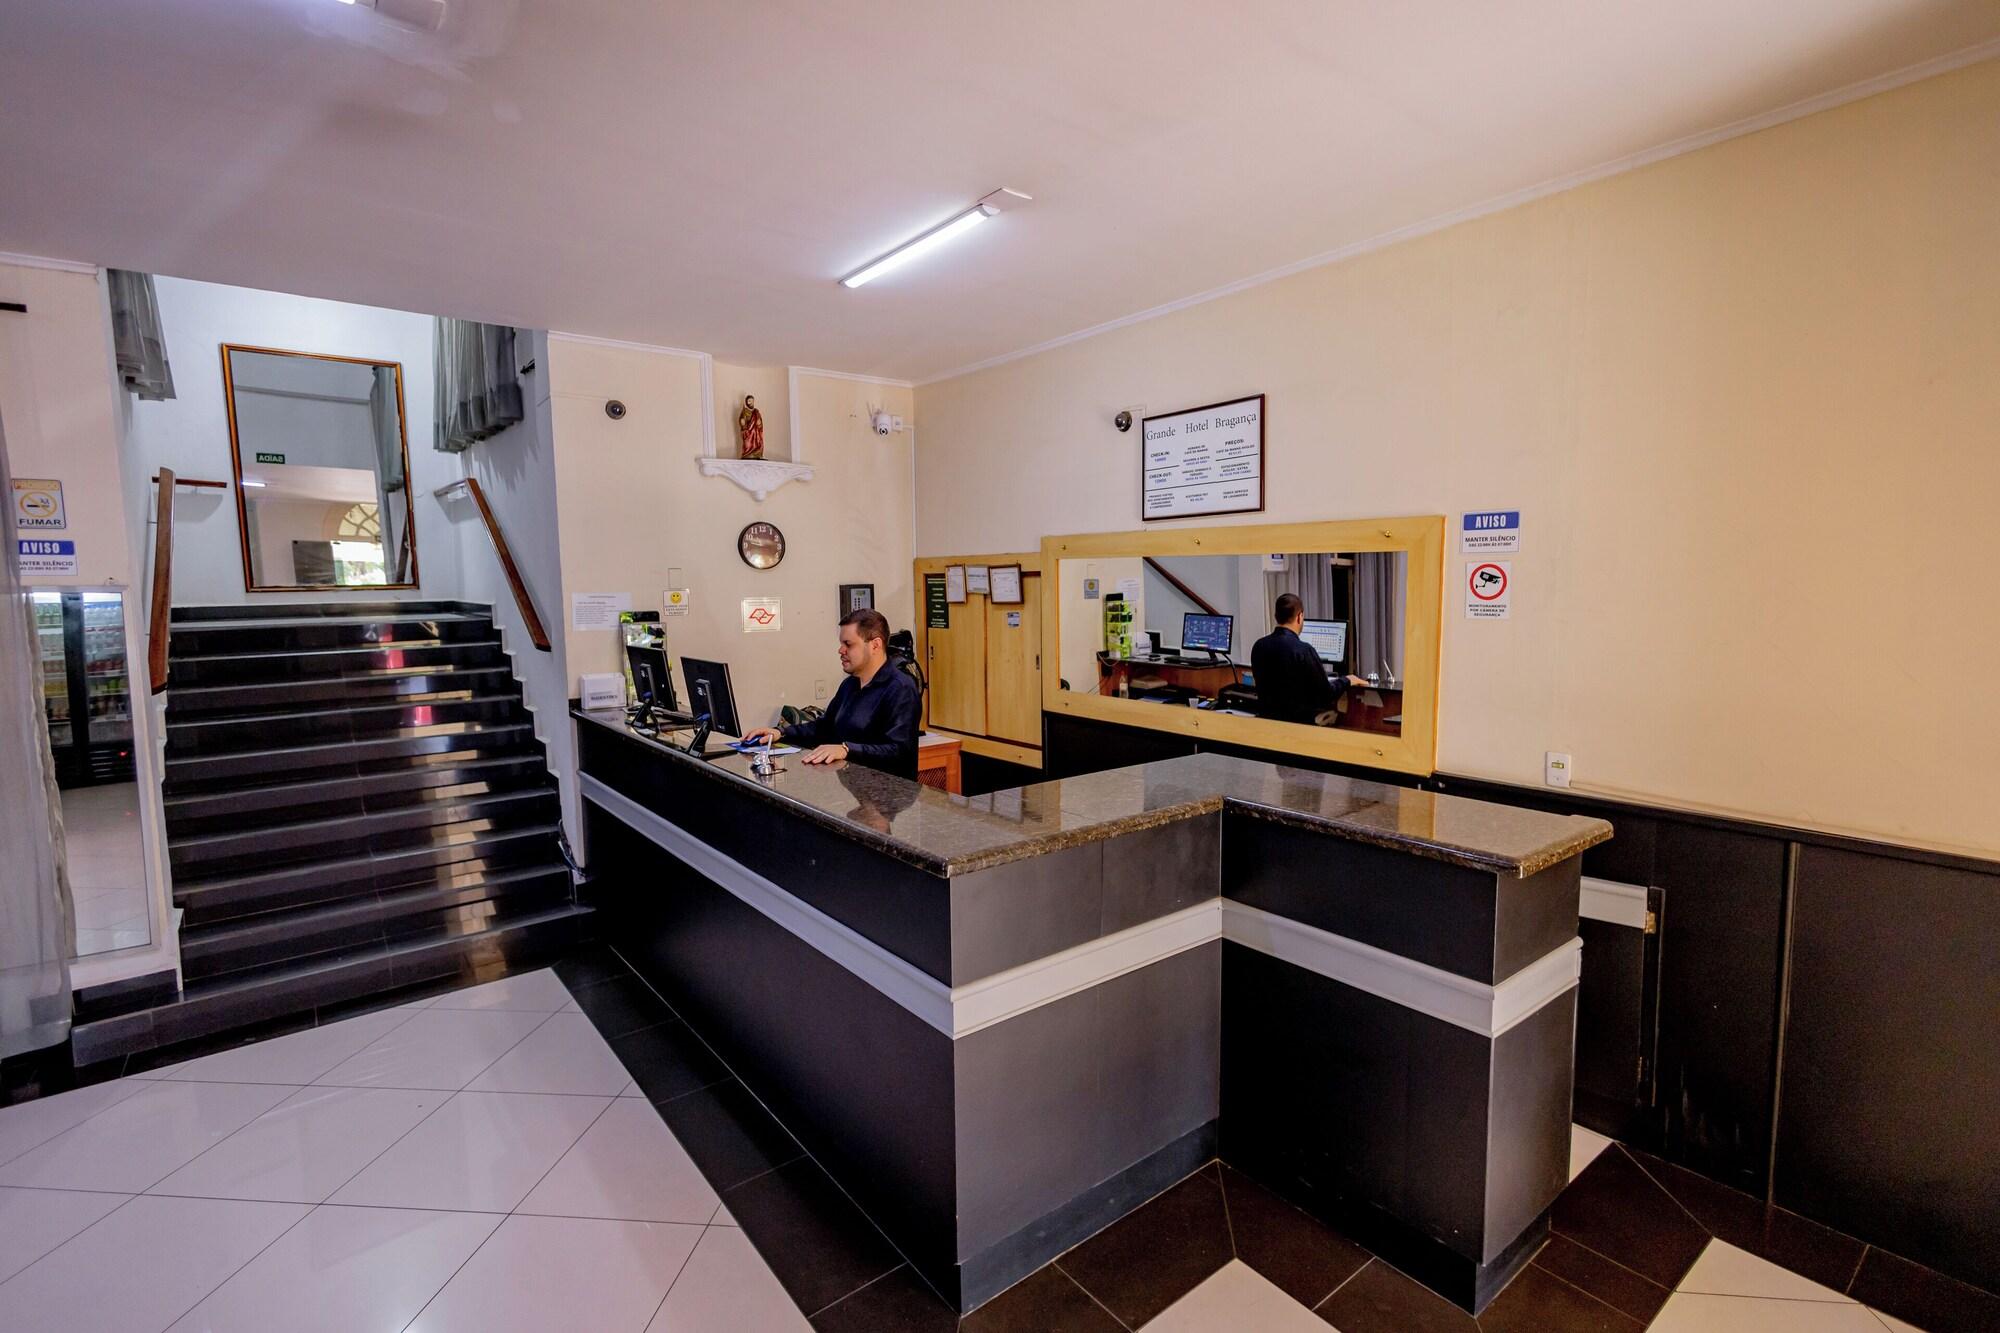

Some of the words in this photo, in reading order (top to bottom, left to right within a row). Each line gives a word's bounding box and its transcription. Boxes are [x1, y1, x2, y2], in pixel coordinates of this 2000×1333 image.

[1146, 427, 1176, 441] Grande
[1185, 419, 1209, 434] Hotel
[1215, 413, 1257, 429] Bragança
[1475, 515, 1506, 528] AVISO
[22, 542, 60, 554] AVISO
